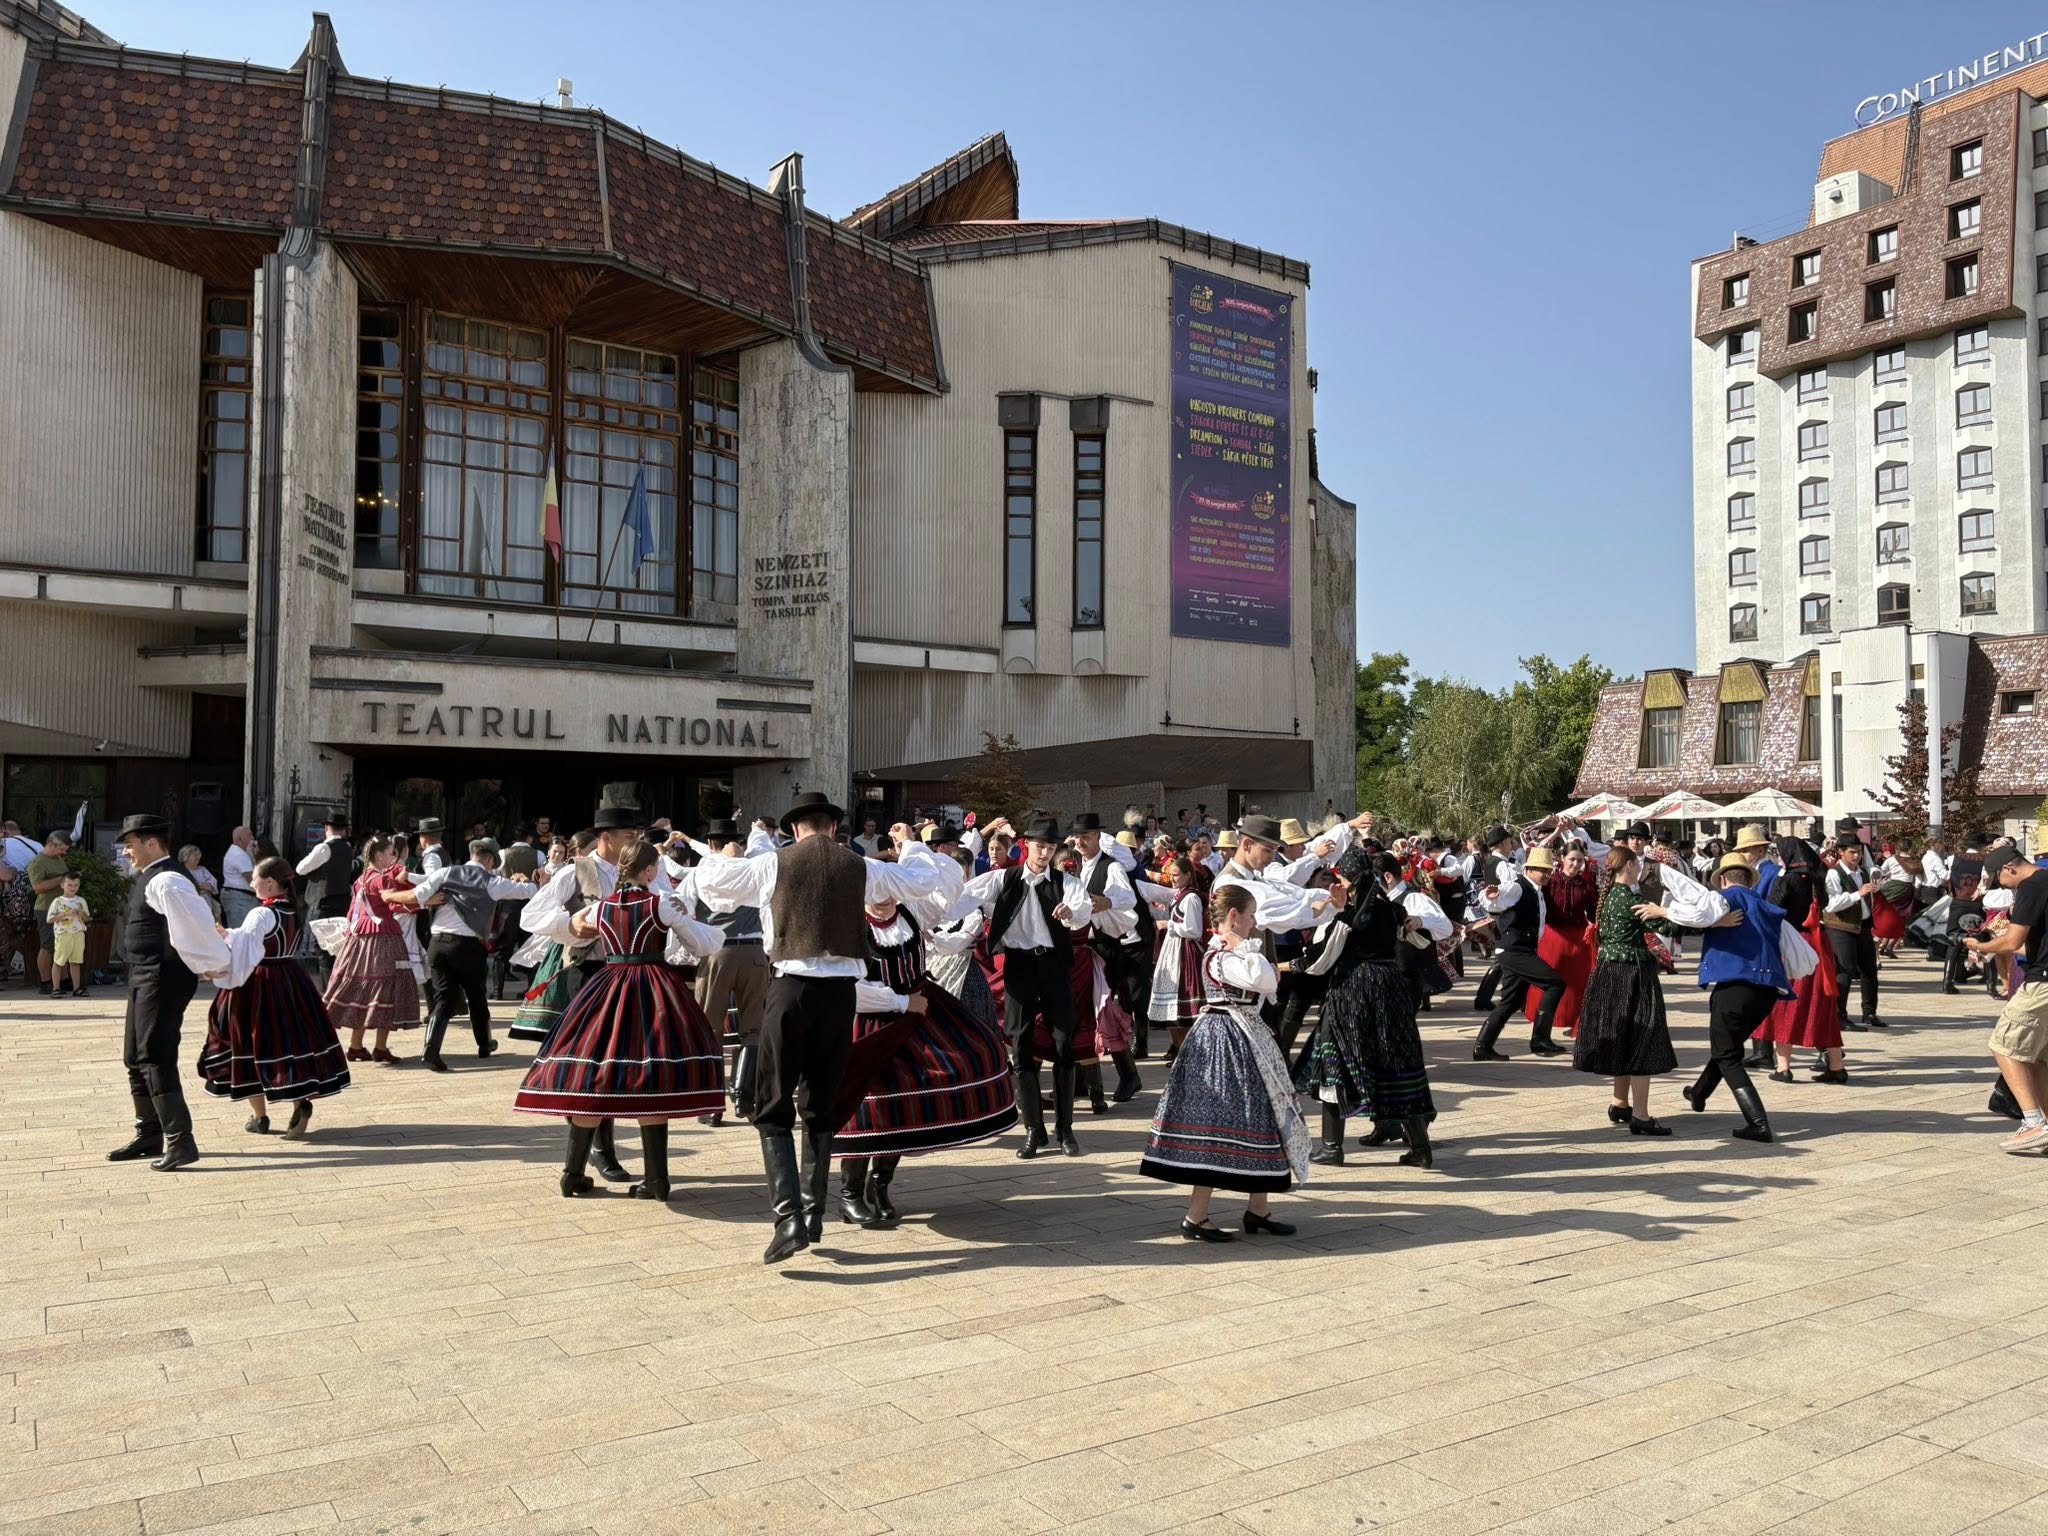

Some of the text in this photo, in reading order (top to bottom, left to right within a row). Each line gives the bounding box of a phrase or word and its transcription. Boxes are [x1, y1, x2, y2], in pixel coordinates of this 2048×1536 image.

[755, 551, 830, 573] NEMZETI
[752, 595, 786, 608] TOMPA
[362, 701, 780, 749] TEATRUL NATIONAL
